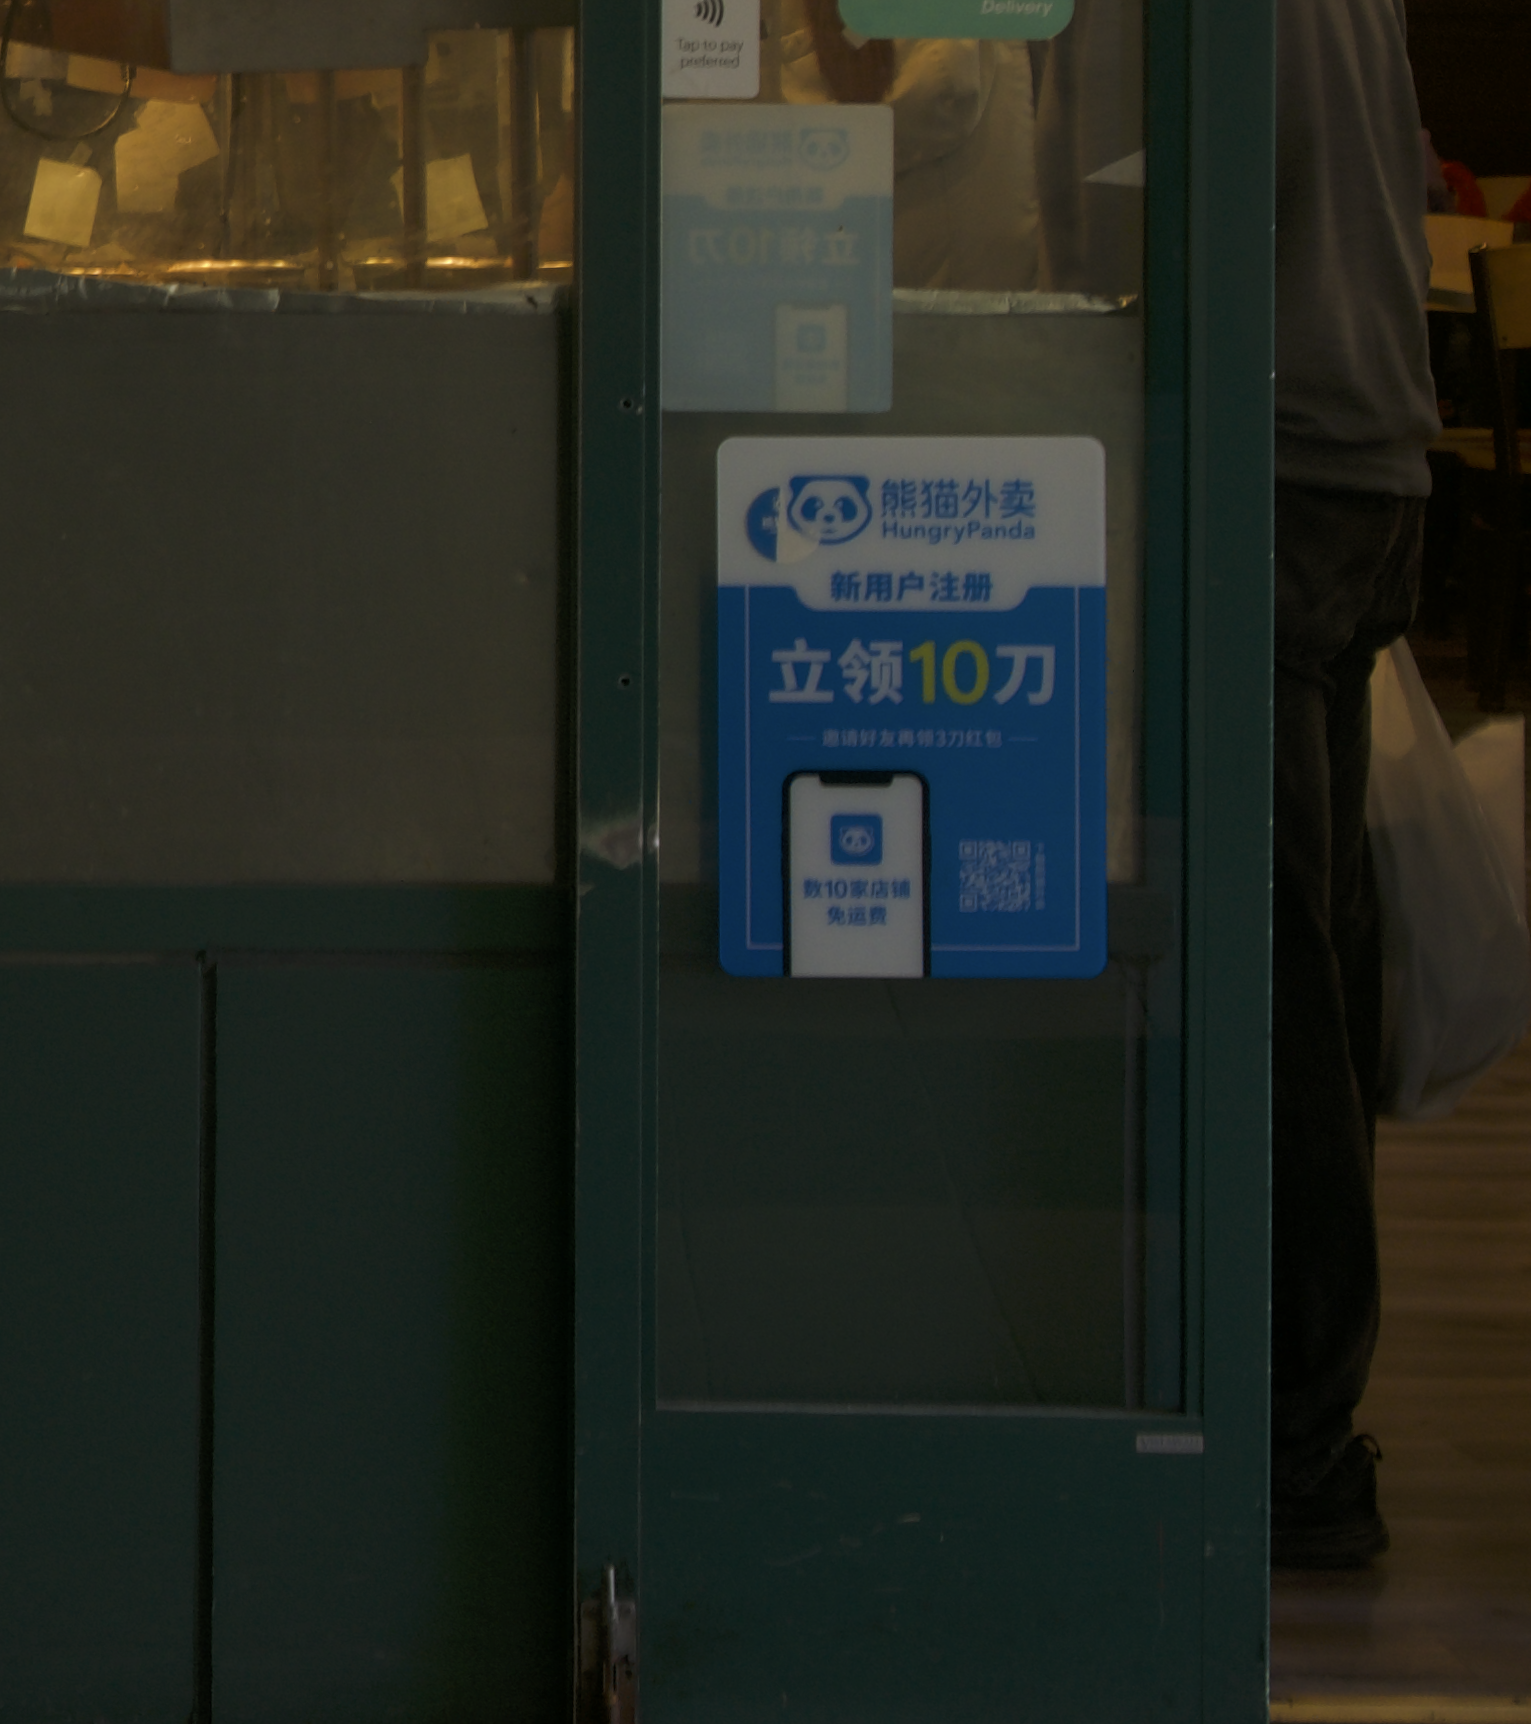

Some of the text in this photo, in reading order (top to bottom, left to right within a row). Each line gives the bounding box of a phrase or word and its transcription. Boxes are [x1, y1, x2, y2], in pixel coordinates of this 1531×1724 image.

[676, 37, 744, 55] Tap to pay
[680, 54, 741, 70] preferred
[881, 478, 1036, 519] 熊猫外卖
[881, 520, 1036, 545] HungryPanda
[830, 570, 993, 603] 新用户注册
[768, 637, 1057, 706] 立领10刀
[827, 905, 888, 927] 免运费
